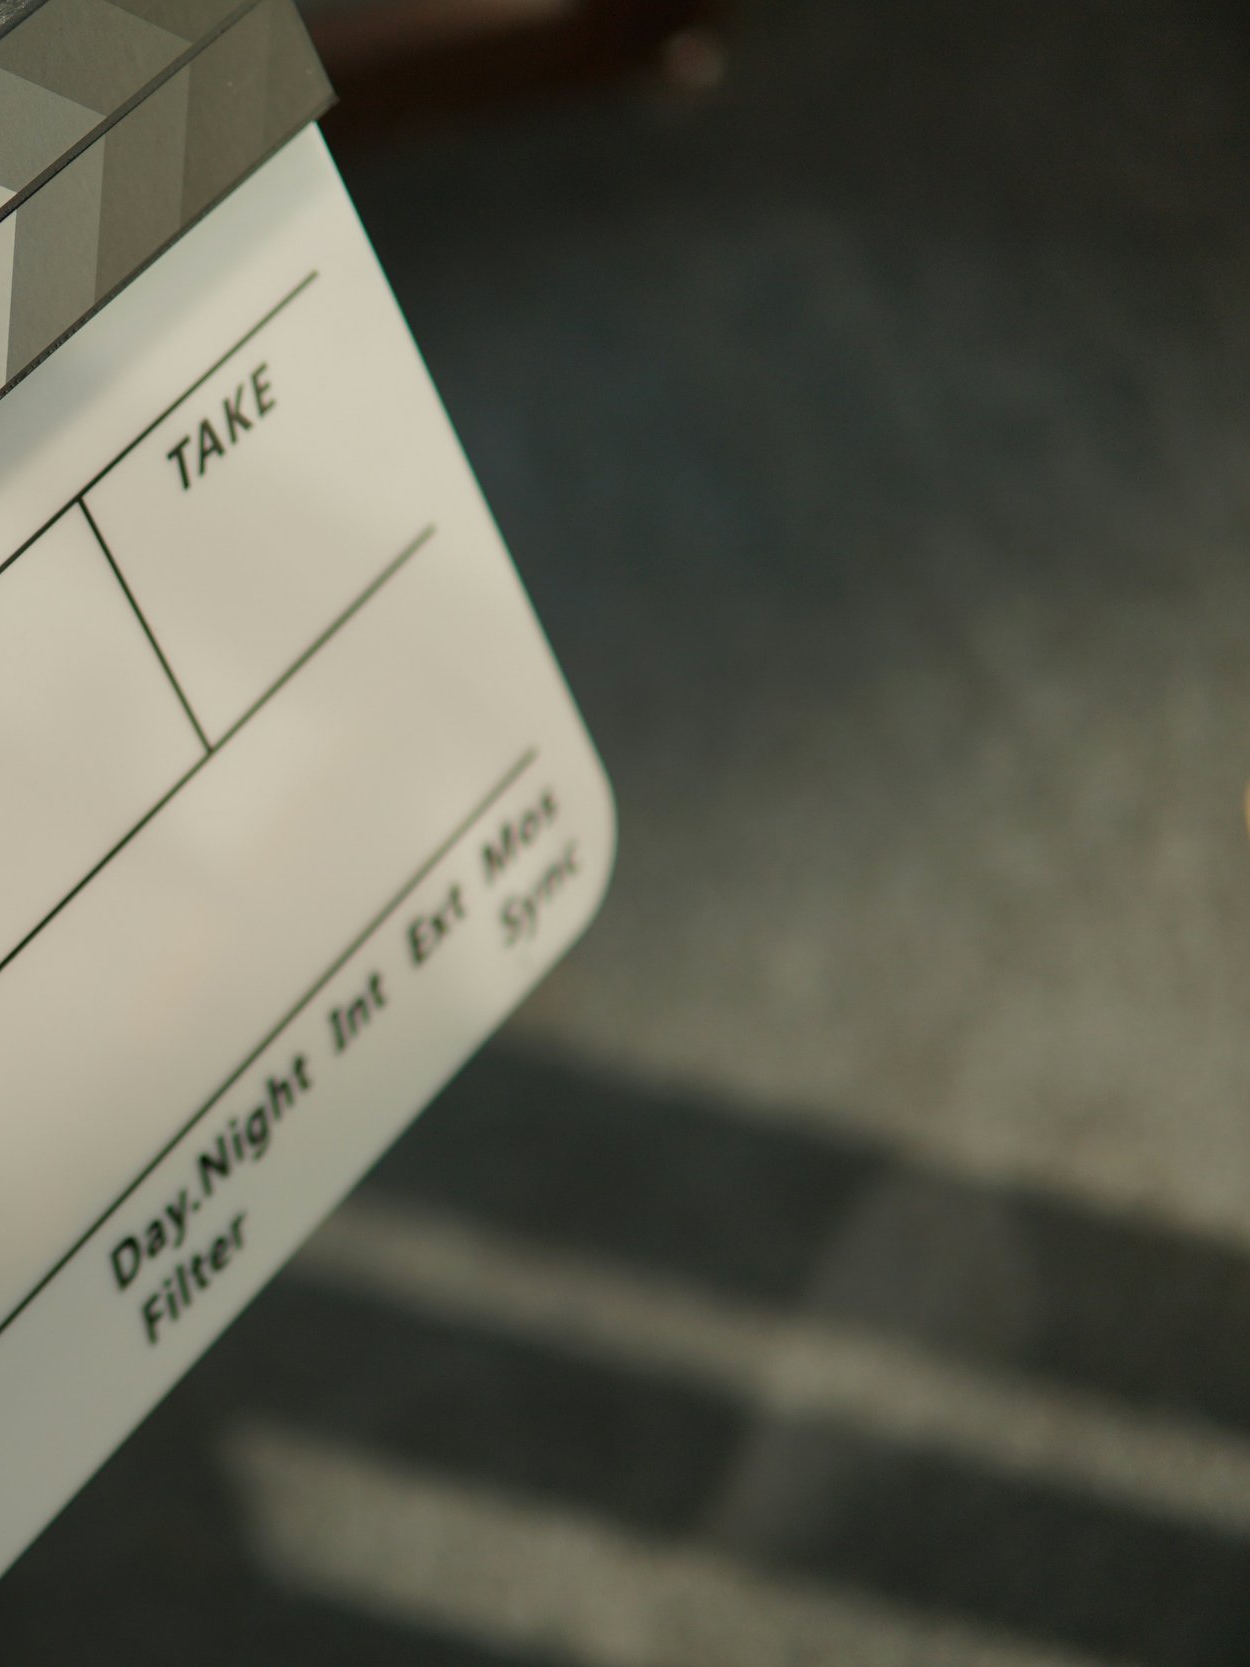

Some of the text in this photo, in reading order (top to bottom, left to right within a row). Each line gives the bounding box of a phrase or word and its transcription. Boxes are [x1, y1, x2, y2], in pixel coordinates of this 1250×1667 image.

[166, 363, 277, 491] TAKE
[496, 838, 580, 948] Sync
[327, 970, 388, 1054] Int
[404, 882, 466, 968] Ext
[140, 1211, 246, 1346] Filter
